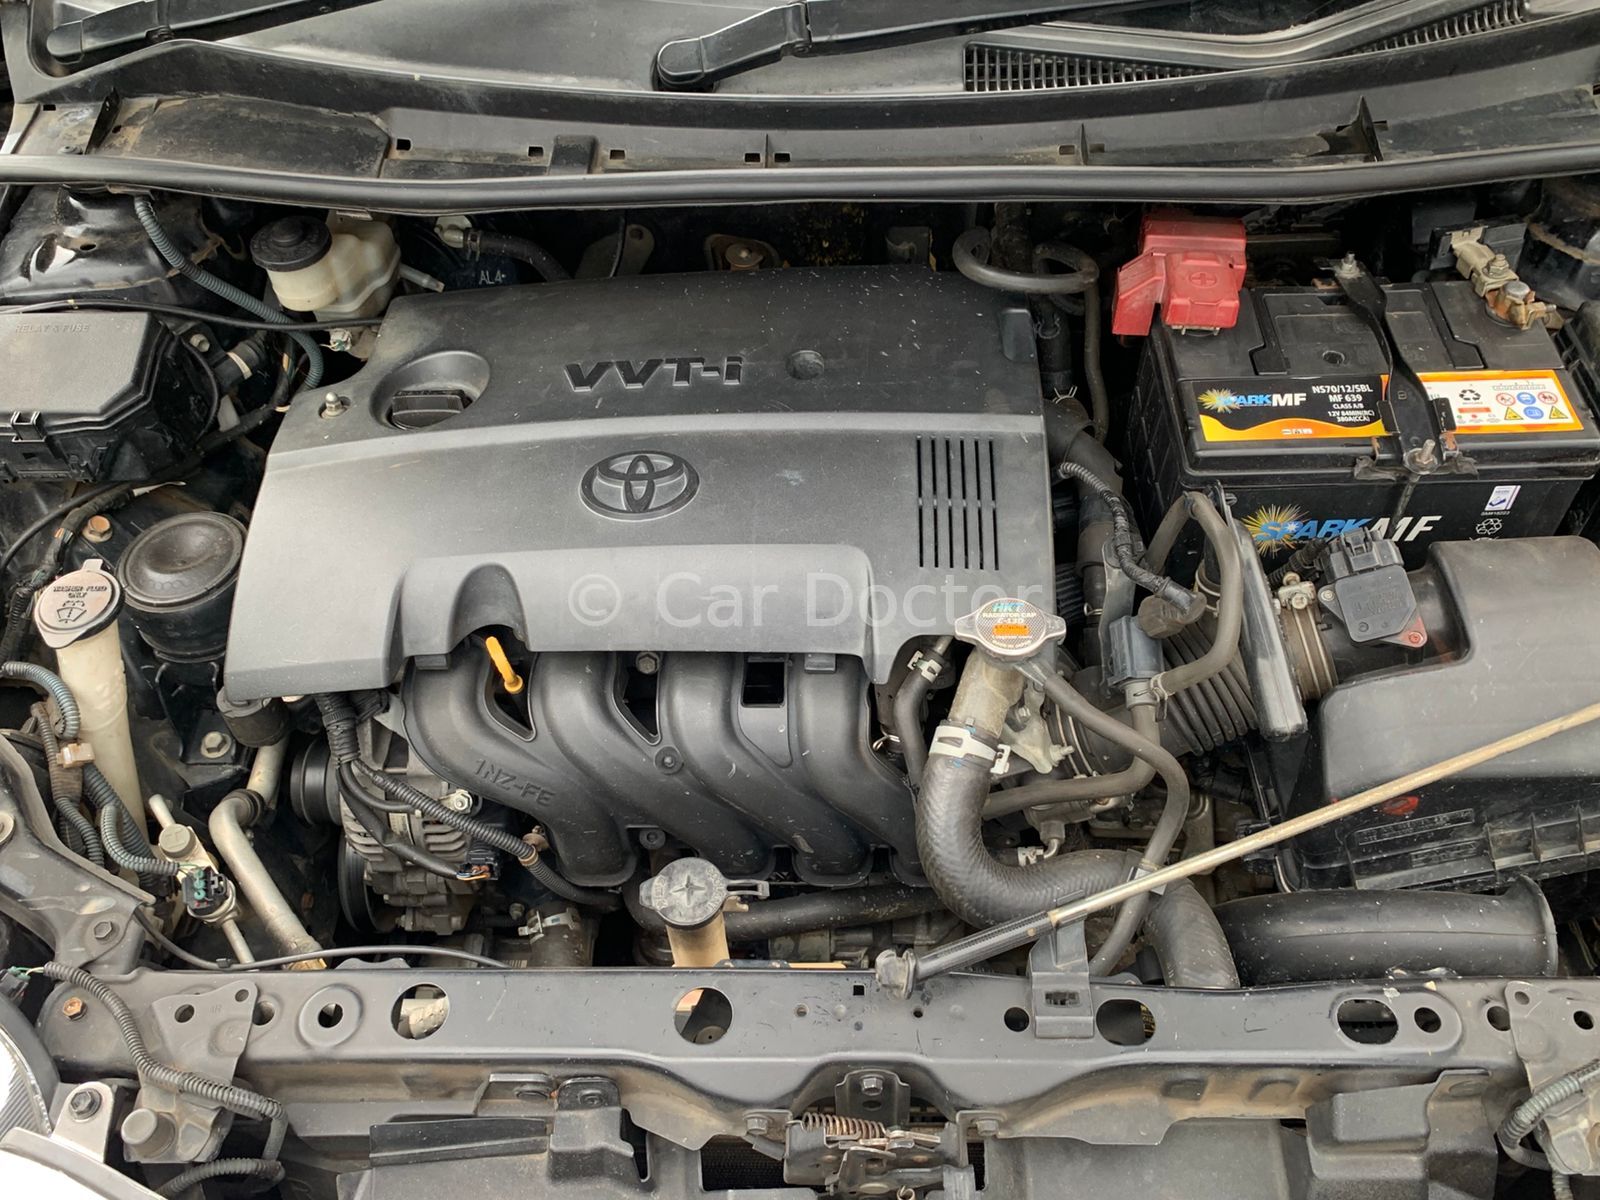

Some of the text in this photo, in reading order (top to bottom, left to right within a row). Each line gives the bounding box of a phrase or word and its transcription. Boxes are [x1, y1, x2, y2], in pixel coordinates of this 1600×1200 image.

[63, 324, 91, 334] FUSE
[563, 356, 744, 393] VVT-i
[1328, 394, 1363, 402] MF 639
[475, 759, 555, 806] 1NZ-FE
